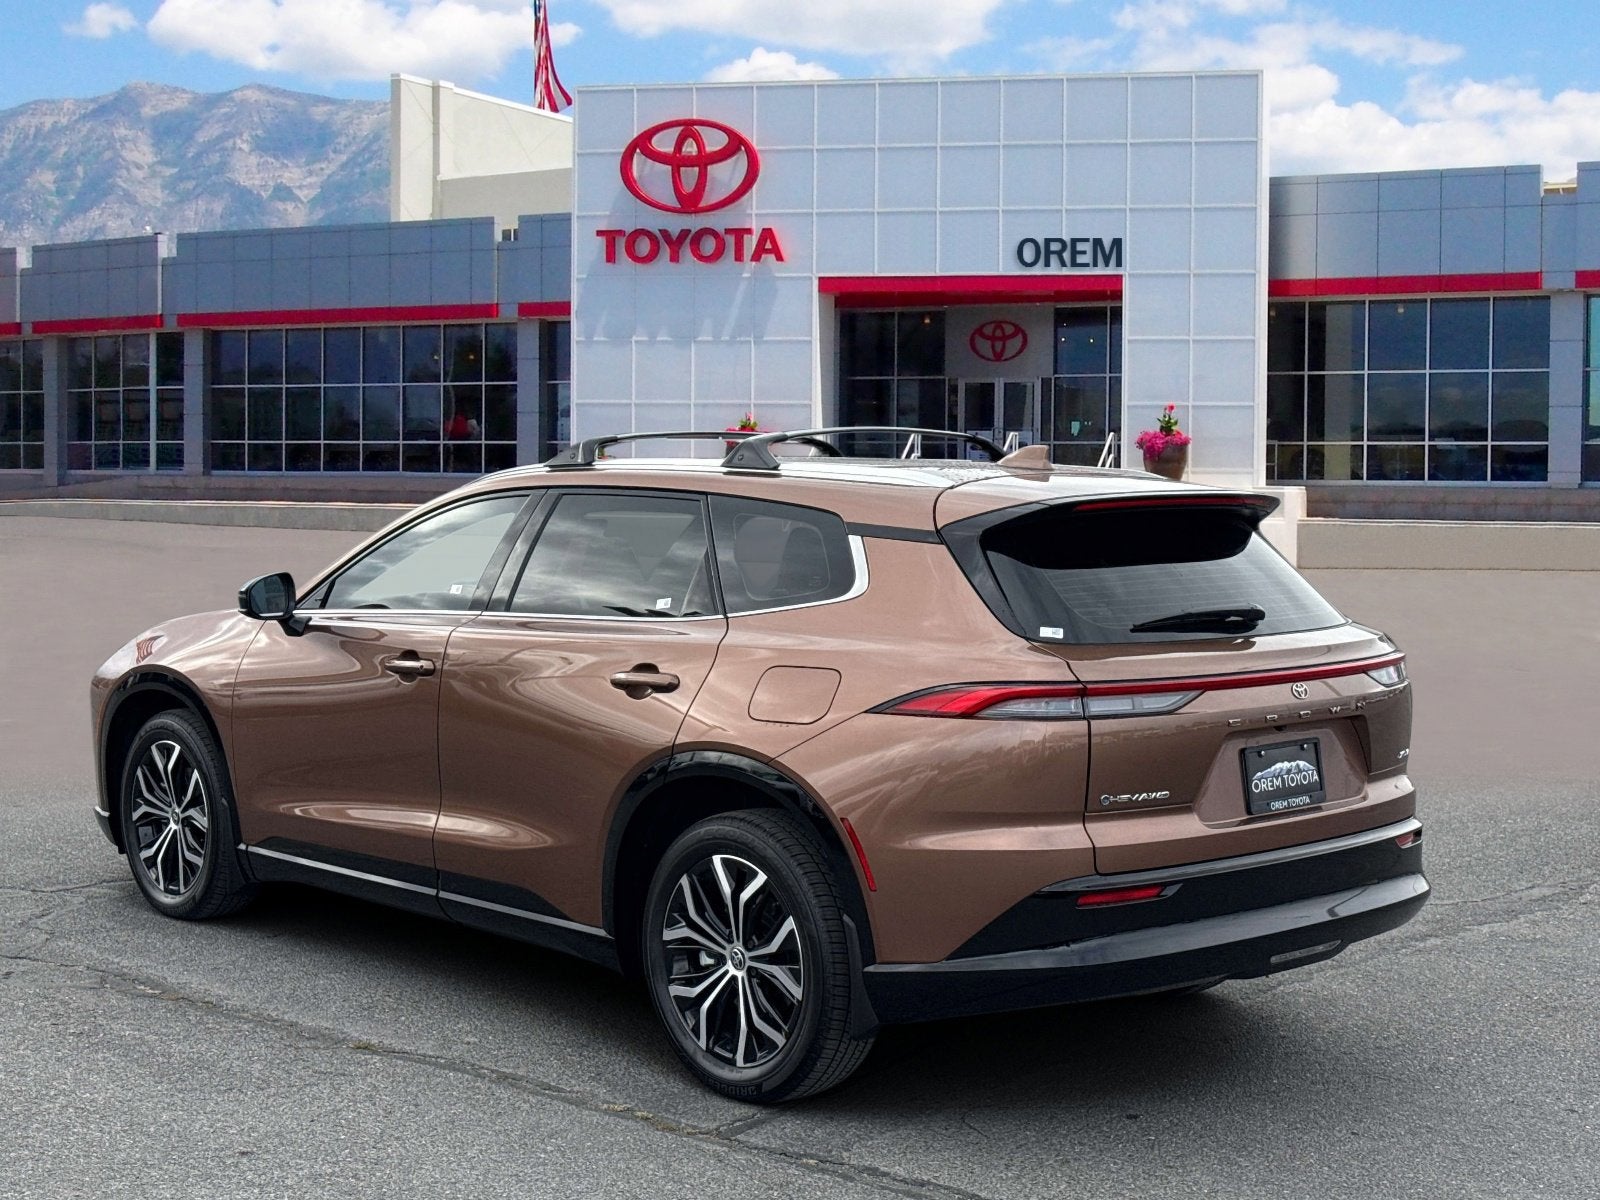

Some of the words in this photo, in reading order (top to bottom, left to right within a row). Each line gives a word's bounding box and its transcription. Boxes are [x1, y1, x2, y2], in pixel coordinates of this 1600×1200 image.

[596, 227, 785, 264] TOYOTA
[1017, 237, 1123, 269] OREM
[1228, 701, 1366, 728] CROWN
[1251, 776, 1282, 793] OREM
[1283, 769, 1320, 788] TOYOTA
[1270, 800, 1288, 811] OREM
[1288, 795, 1311, 808] TOYOTA
